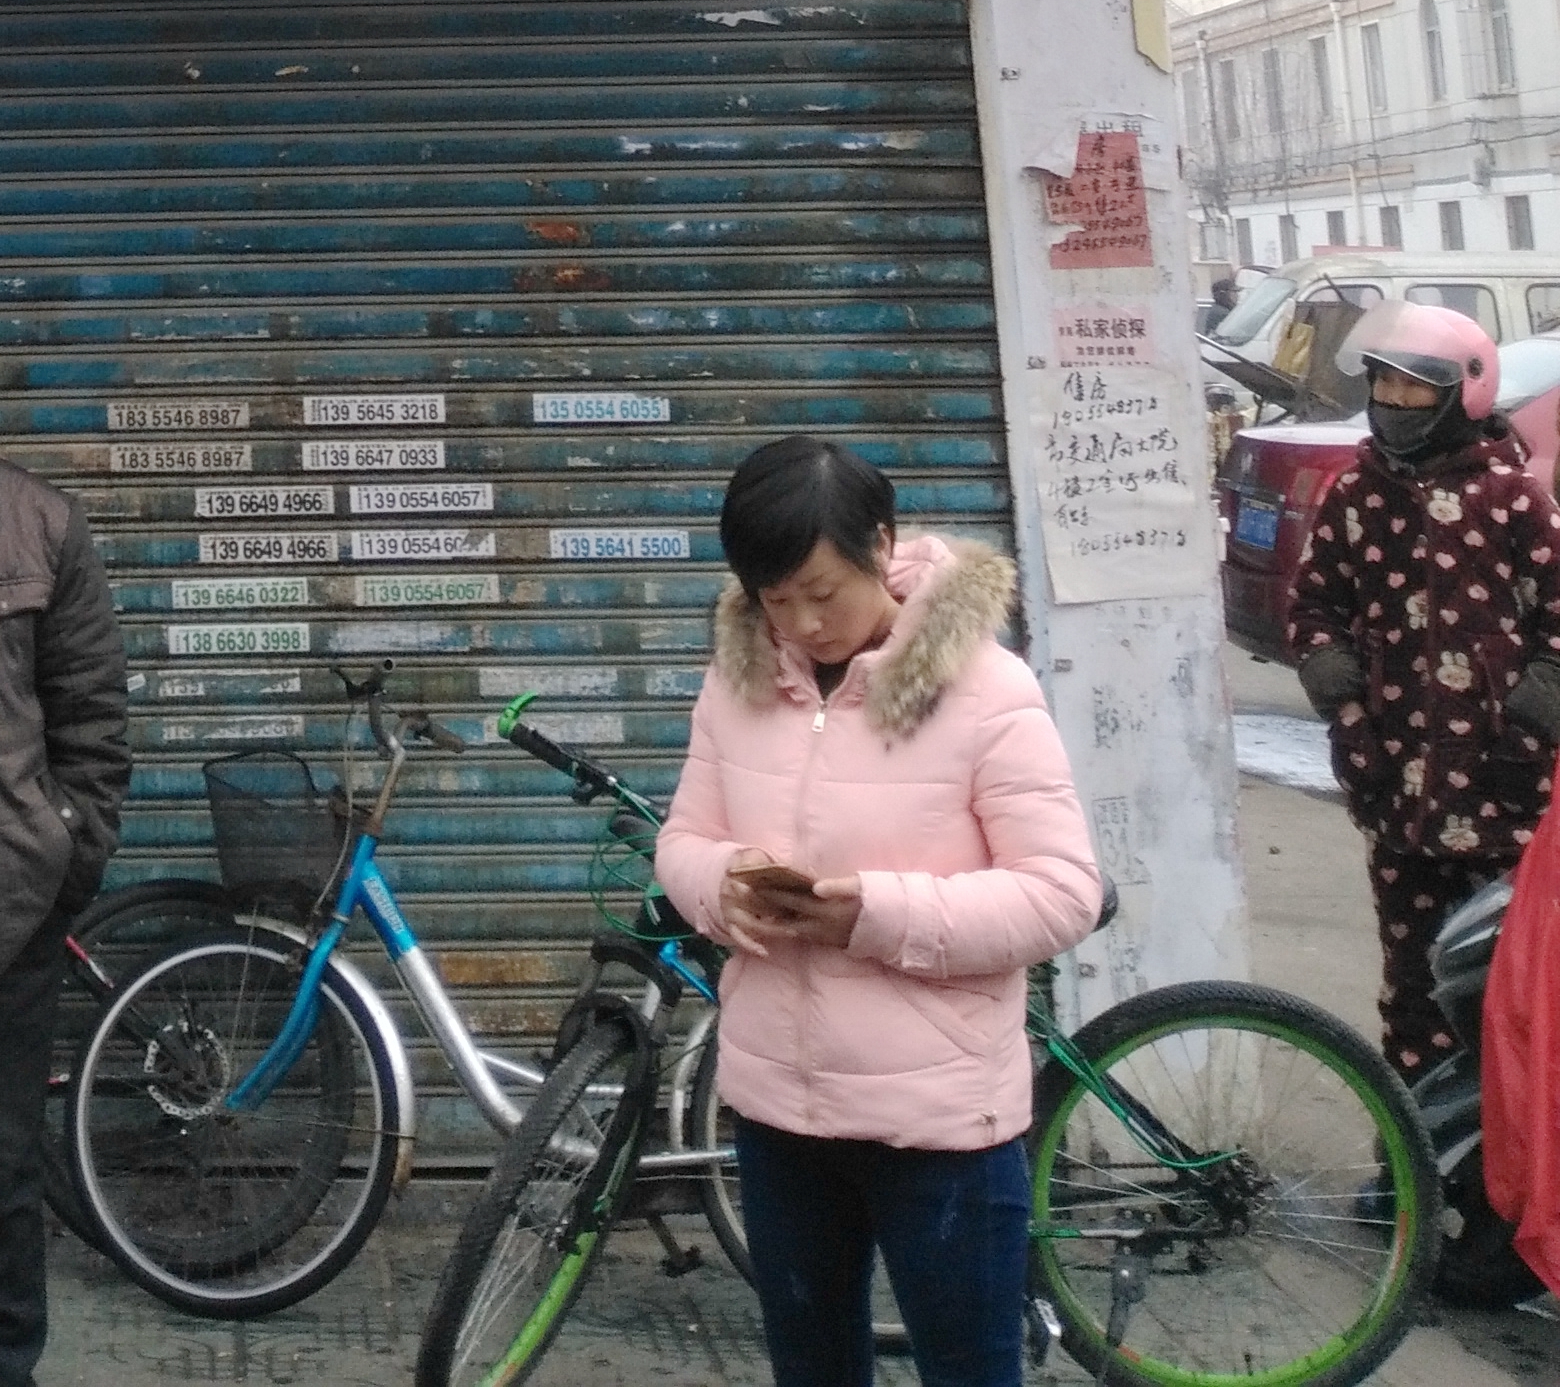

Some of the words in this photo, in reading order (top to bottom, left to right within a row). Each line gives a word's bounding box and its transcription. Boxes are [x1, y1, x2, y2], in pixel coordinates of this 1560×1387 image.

[1075, 318, 1147, 339] 私家侦探
[116, 410, 147, 427] 183
[152, 410, 194, 426] 5546
[199, 409, 241, 425] 8987
[322, 404, 350, 421] 139
[357, 404, 394, 420] 5645
[401, 403, 438, 420] 3218
[540, 400, 569, 419] 135
[574, 400, 615, 419] 0554
[621, 399, 661, 419] 6055
[119, 452, 149, 468] 183
[155, 451, 196, 468] 5546
[202, 451, 243, 467] 8987
[322, 450, 349, 466] 139
[356, 449, 394, 466] 6647
[399, 449, 438, 465] 0933
[207, 495, 235, 514] 139
[239, 494, 279, 513] 6649
[283, 493, 323, 512] 4966
[364, 492, 395, 509] 139
[400, 491, 439, 508] 0554
[441, 490, 480, 507] 6057
[211, 541, 238, 560] 139
[243, 540, 282, 559] 6649
[287, 539, 326, 558] 4966
[366, 538, 398, 554] 139
[402, 537, 440, 554] 0554
[561, 538, 589, 556] 139
[595, 537, 634, 556] 5641
[641, 537, 681, 556] 5500
[183, 589, 211, 606] 139
[215, 588, 255, 605] 6646
[259, 586, 299, 603] 0322
[370, 585, 401, 602] 139
[405, 584, 443, 601] 0554
[446, 583, 484, 600] 6057
[183, 632, 212, 652] 138
[216, 631, 256, 651] 6630
[260, 630, 301, 651] 3998
